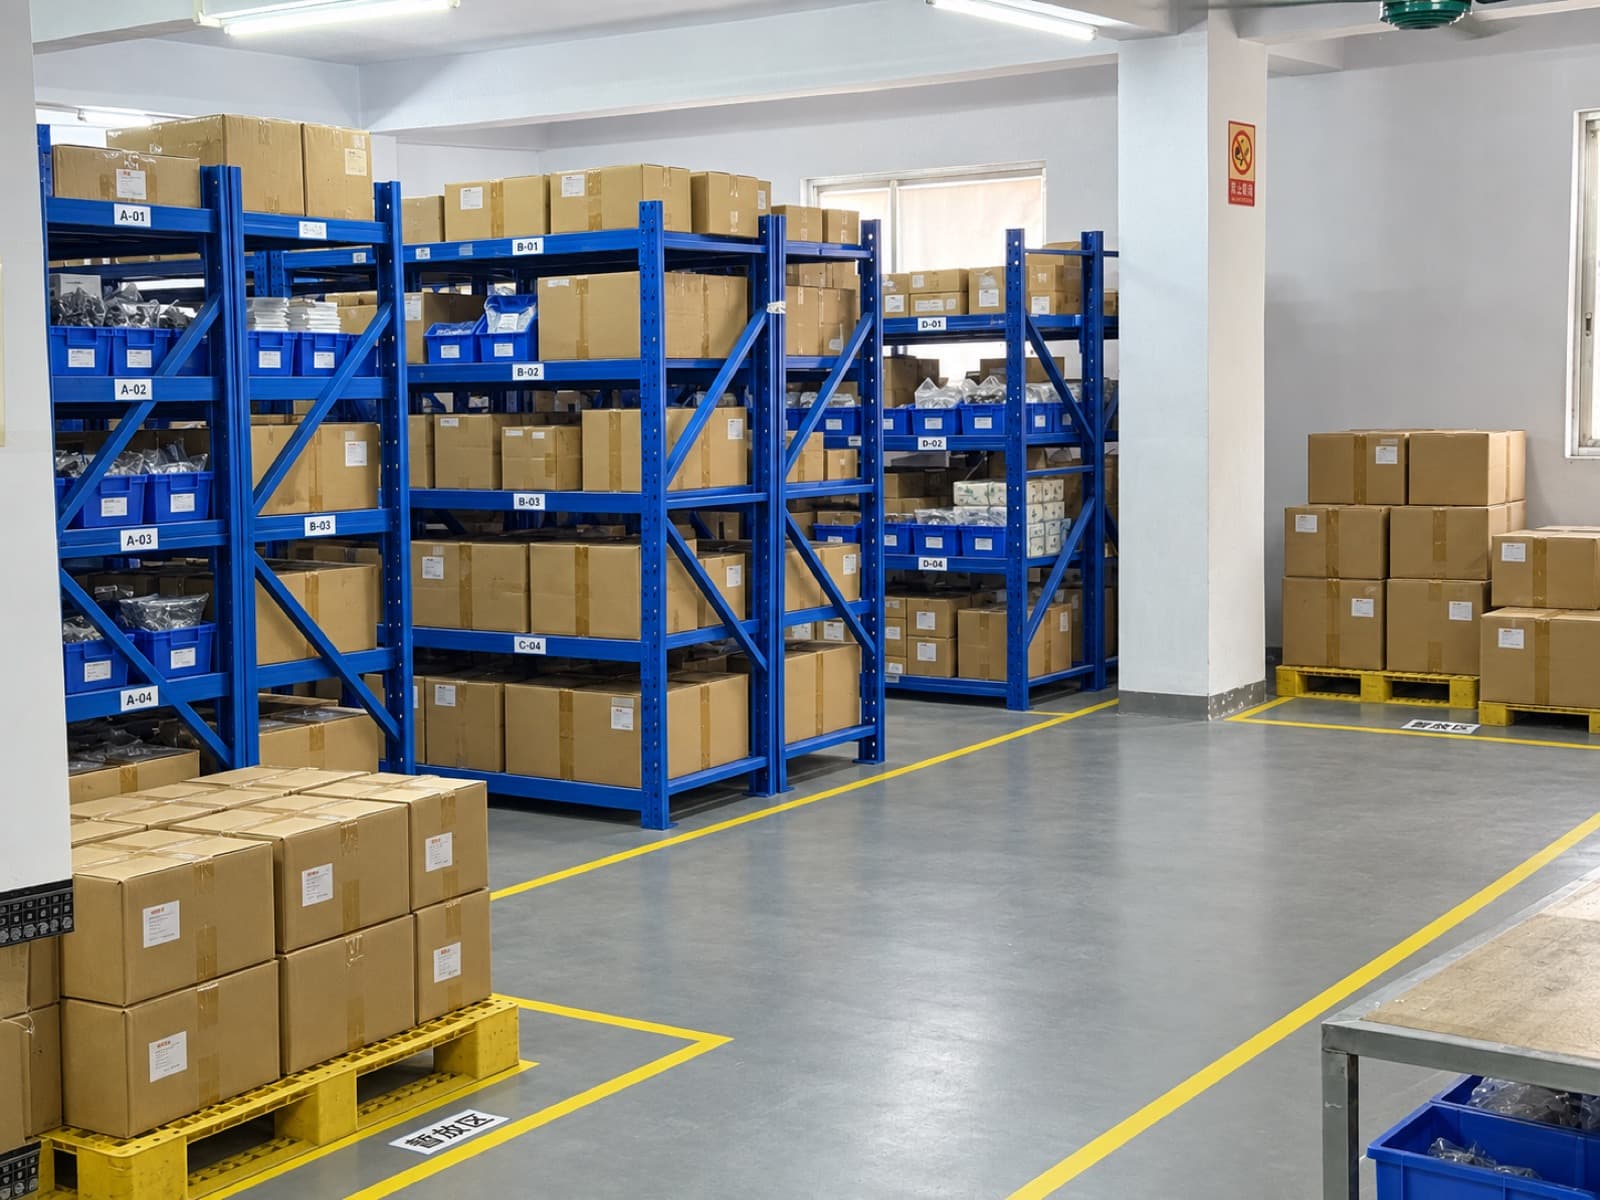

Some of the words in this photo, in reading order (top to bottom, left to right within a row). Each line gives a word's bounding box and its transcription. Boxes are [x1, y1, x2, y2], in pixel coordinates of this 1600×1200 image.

[120, 210, 145, 222] A-01
[517, 242, 538, 252] B-01
[922, 321, 941, 329] D-01
[518, 368, 538, 377] B-02
[121, 384, 146, 395] A-02
[923, 440, 943, 448] D-02
[519, 498, 540, 507] B-03
[310, 520, 331, 531] B-03
[127, 534, 152, 546] A-03
[923, 560, 943, 568] D-04
[519, 641, 540, 650] C-04
[126, 692, 152, 705] A-04
[404, 1113, 495, 1149] 暂放区
